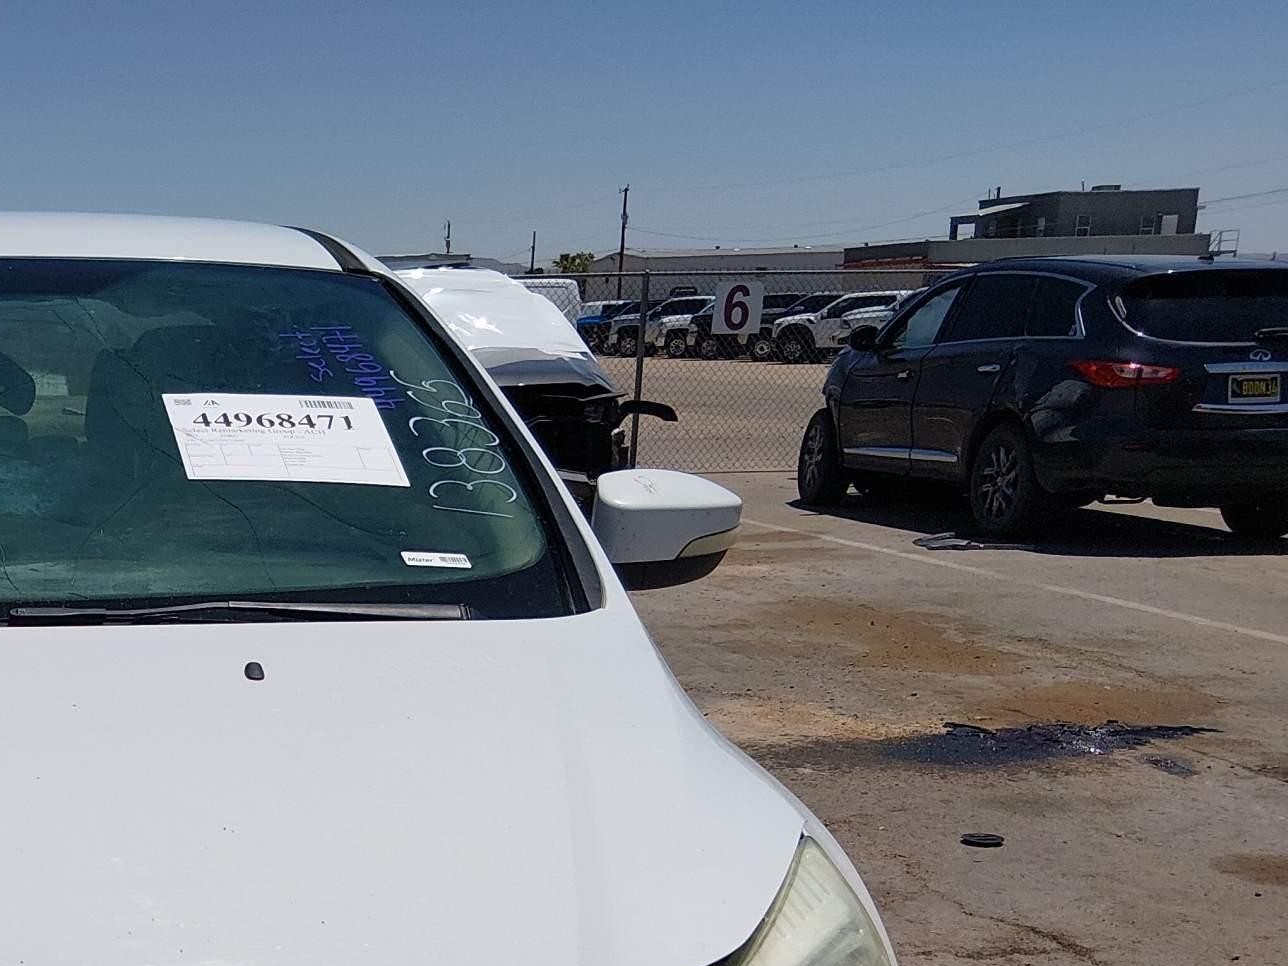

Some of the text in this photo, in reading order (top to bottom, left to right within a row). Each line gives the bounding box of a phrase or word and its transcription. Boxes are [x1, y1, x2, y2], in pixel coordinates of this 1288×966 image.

[724, 285, 750, 330] 6
[310, 327, 405, 409] 44968471
[192, 412, 355, 431] 44968471
[390, 370, 517, 517] 138365
